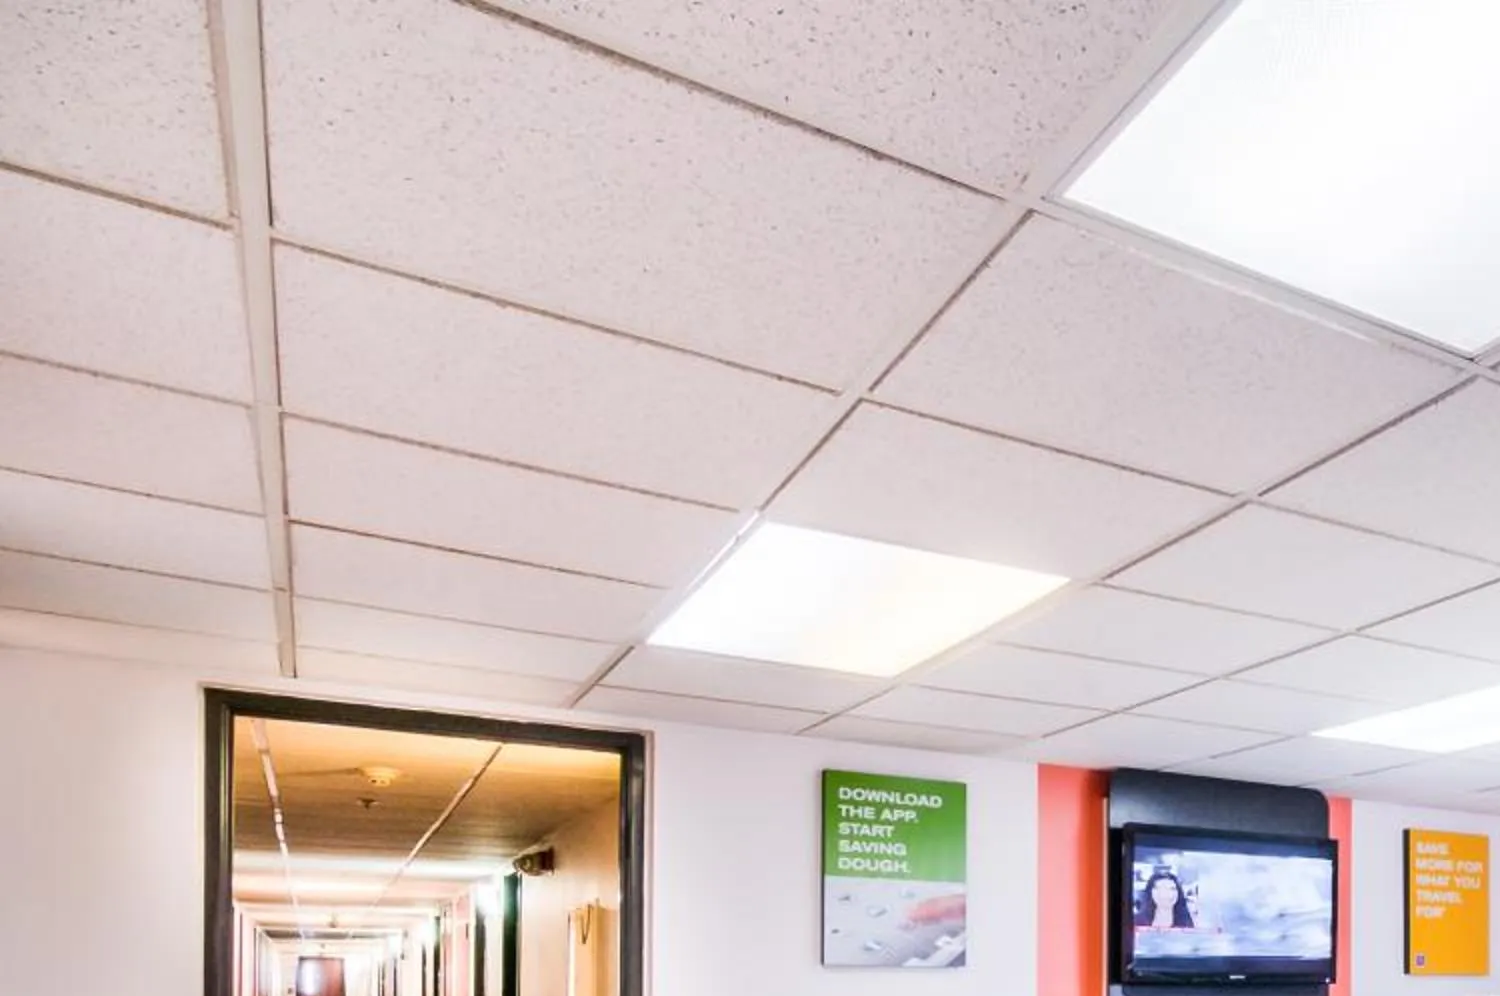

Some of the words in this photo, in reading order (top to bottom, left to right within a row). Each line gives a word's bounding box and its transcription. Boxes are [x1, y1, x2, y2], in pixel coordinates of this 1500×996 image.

[838, 787, 942, 808] DOWNLOAD
[838, 805, 876, 819] THE
[880, 808, 919, 823] APP.
[838, 823, 894, 837] START
[838, 840, 907, 855] SAVING
[838, 857, 911, 873] DOUGH.
